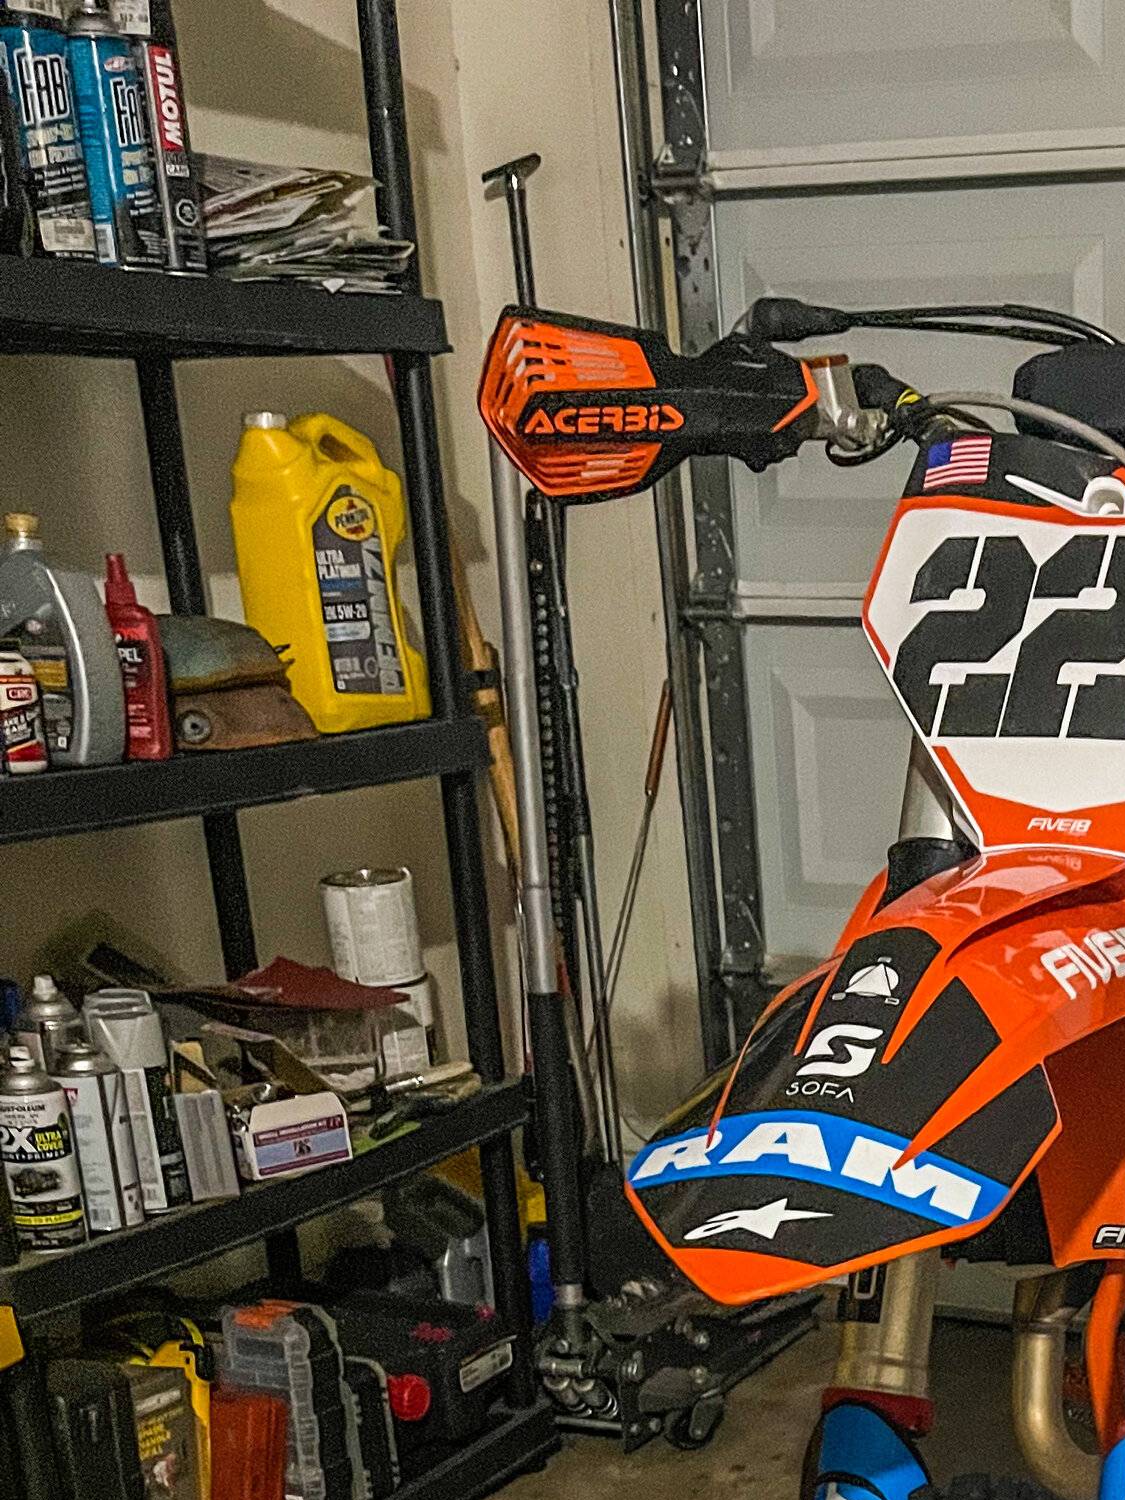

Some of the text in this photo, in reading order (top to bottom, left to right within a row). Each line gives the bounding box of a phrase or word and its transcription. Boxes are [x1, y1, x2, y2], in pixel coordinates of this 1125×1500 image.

[156, 52, 184, 147] MOTUL
[524, 404, 684, 434] ACERBIS
[785, 1081, 855, 1103] SOFA
[631, 1121, 983, 1220] RAM
